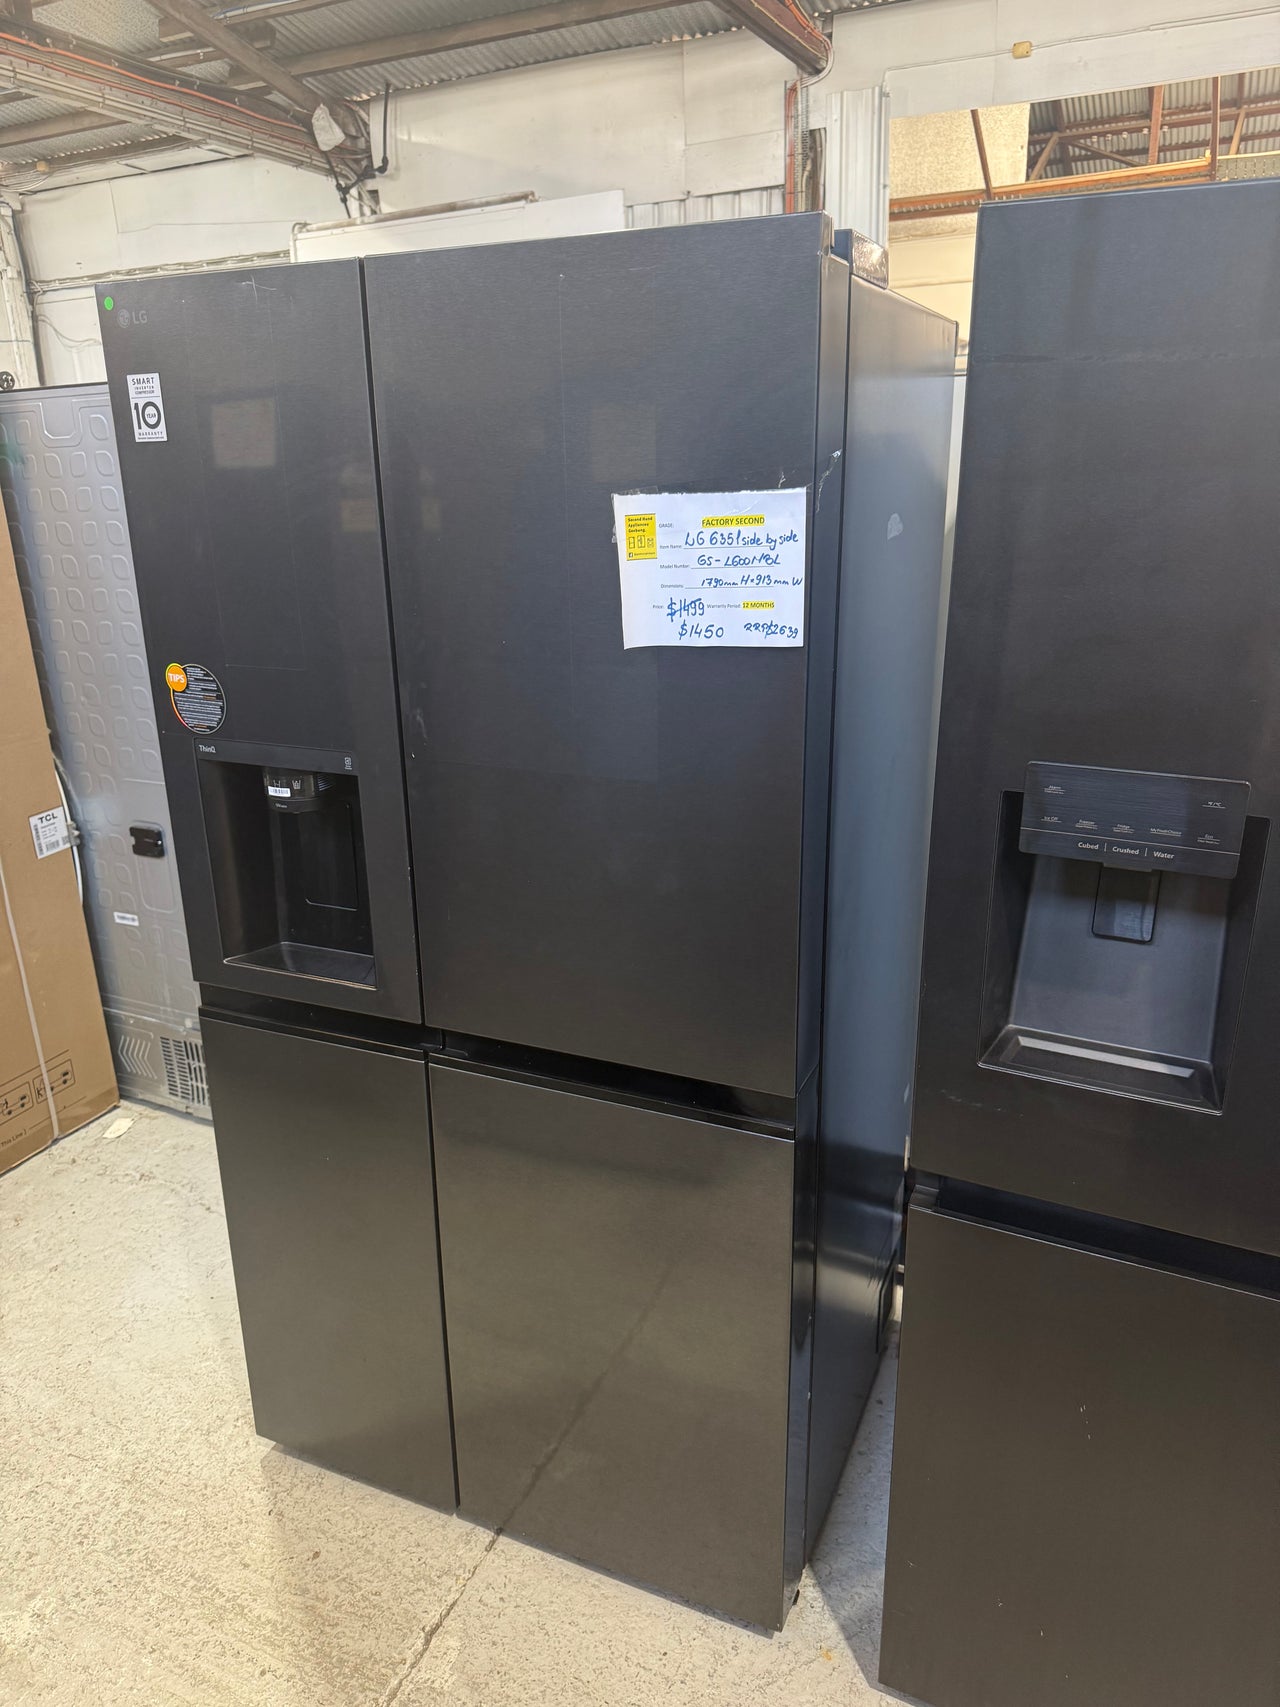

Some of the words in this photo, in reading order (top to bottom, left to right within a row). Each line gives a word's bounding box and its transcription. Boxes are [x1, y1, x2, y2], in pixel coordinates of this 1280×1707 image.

[132, 310, 147, 324] LG
[131, 377, 154, 385] SMART
[134, 401, 161, 430] 10
[702, 518, 734, 527] FACTORY
[735, 516, 765, 525] SECOND
[685, 531, 705, 547] LG
[742, 532, 763, 546] side
[765, 533, 778, 551] by
[779, 529, 799, 545] side
[678, 619, 724, 641] $1450
[168, 673, 185, 683] TIPS
[198, 744, 216, 753] ThinQ
[38, 812, 58, 824] TCL
[1078, 842, 1099, 850] Cubed
[1112, 846, 1140, 855] Crushed
[1153, 851, 1175, 859] Water
